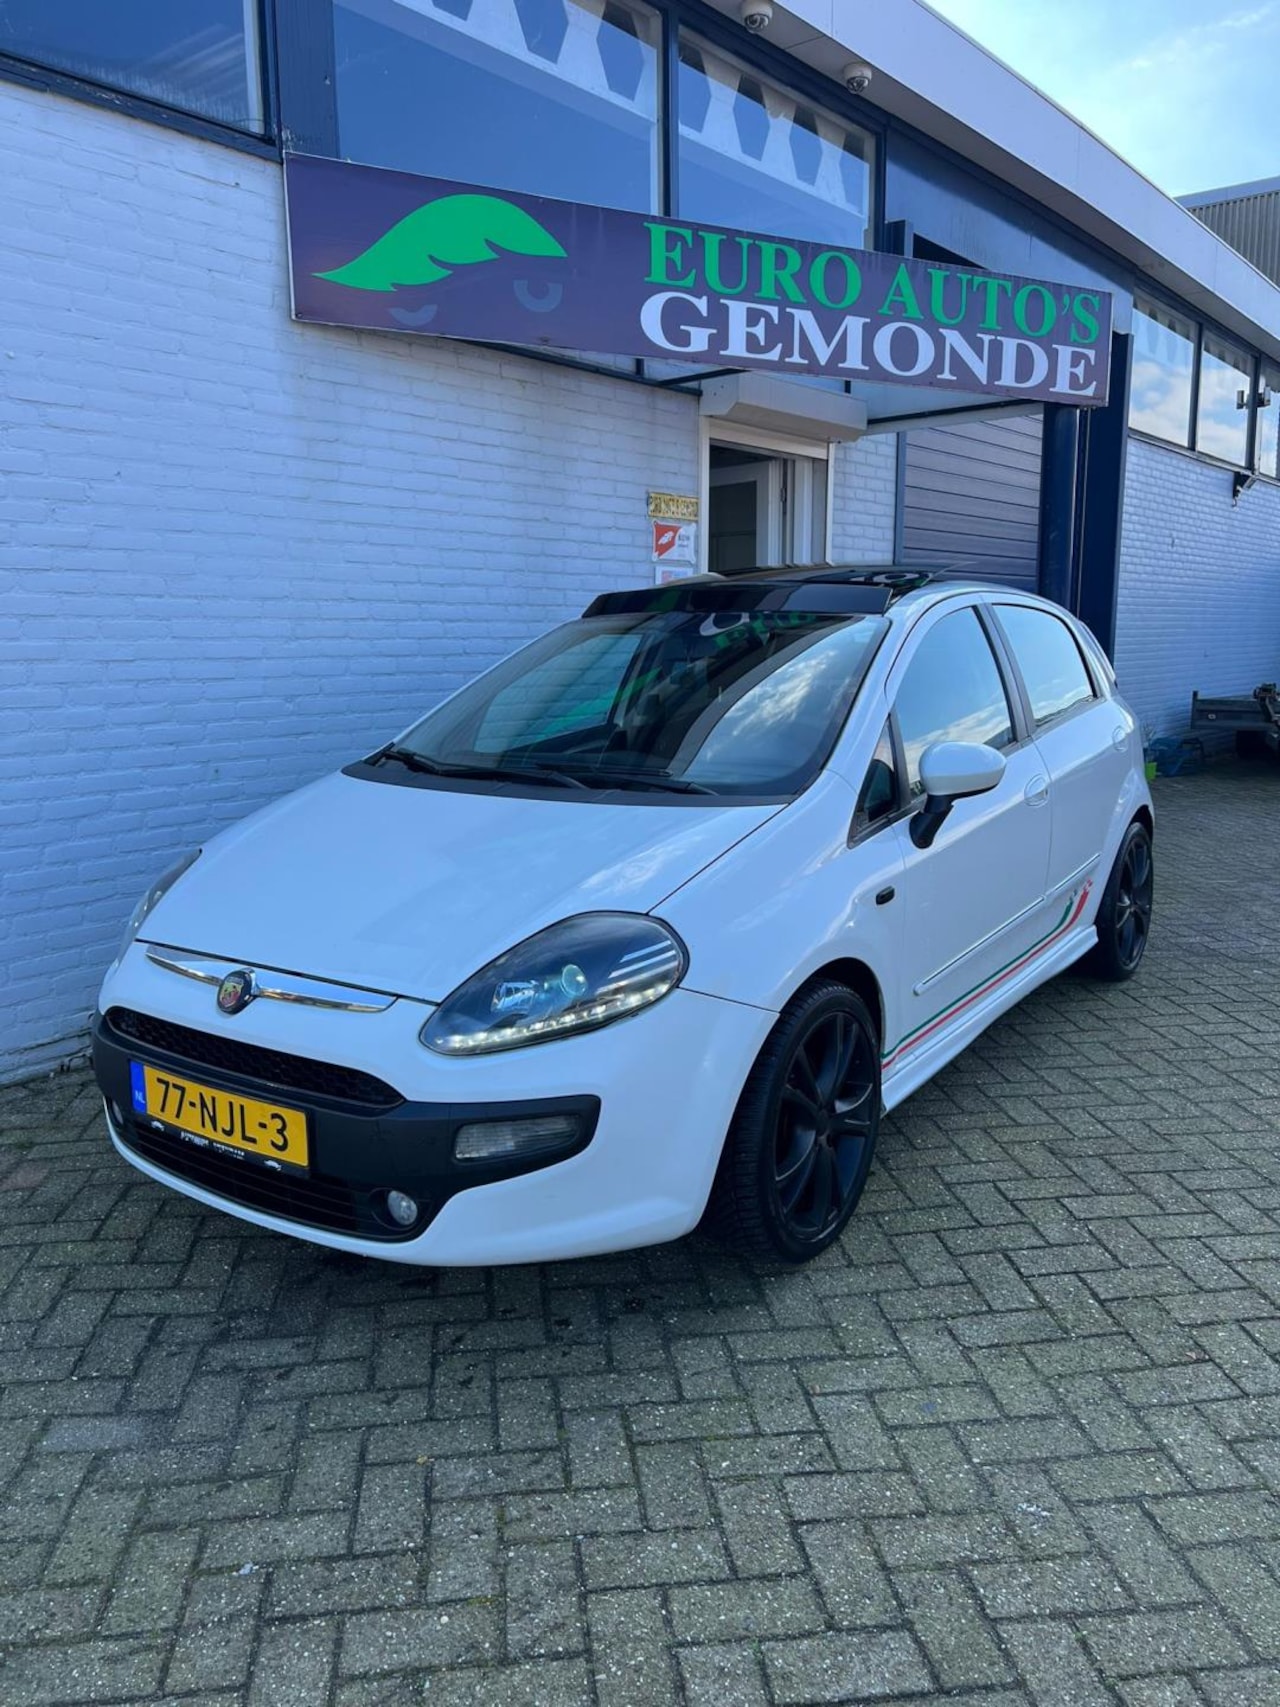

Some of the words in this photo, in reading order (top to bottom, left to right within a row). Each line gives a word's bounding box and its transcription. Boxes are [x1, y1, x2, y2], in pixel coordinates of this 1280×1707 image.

[643, 221, 863, 310] EURO
[877, 262, 1101, 345] AUTO'S
[639, 291, 1097, 397] GEMONDE
[134, 1089, 146, 1104] NL
[156, 1077, 289, 1153] 77-NJL-3
